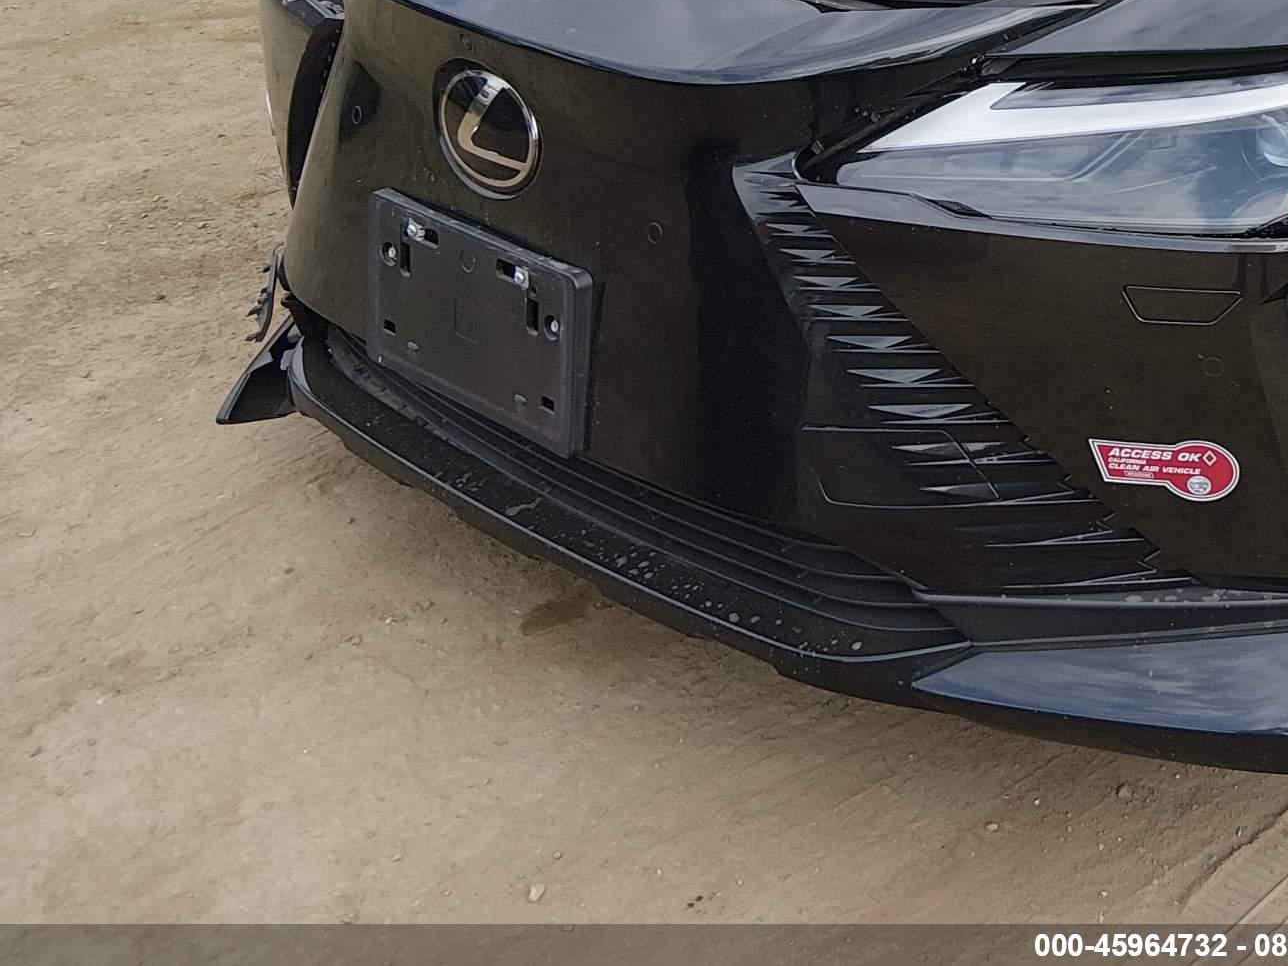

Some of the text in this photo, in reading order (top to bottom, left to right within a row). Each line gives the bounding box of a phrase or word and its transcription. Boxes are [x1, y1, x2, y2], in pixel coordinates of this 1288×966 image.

[1108, 447, 1202, 462] ACCESS OK
[1108, 463, 1140, 471] CLEAN
[1142, 465, 1160, 473] AIR
[1162, 467, 1202, 475] VEHICLE
